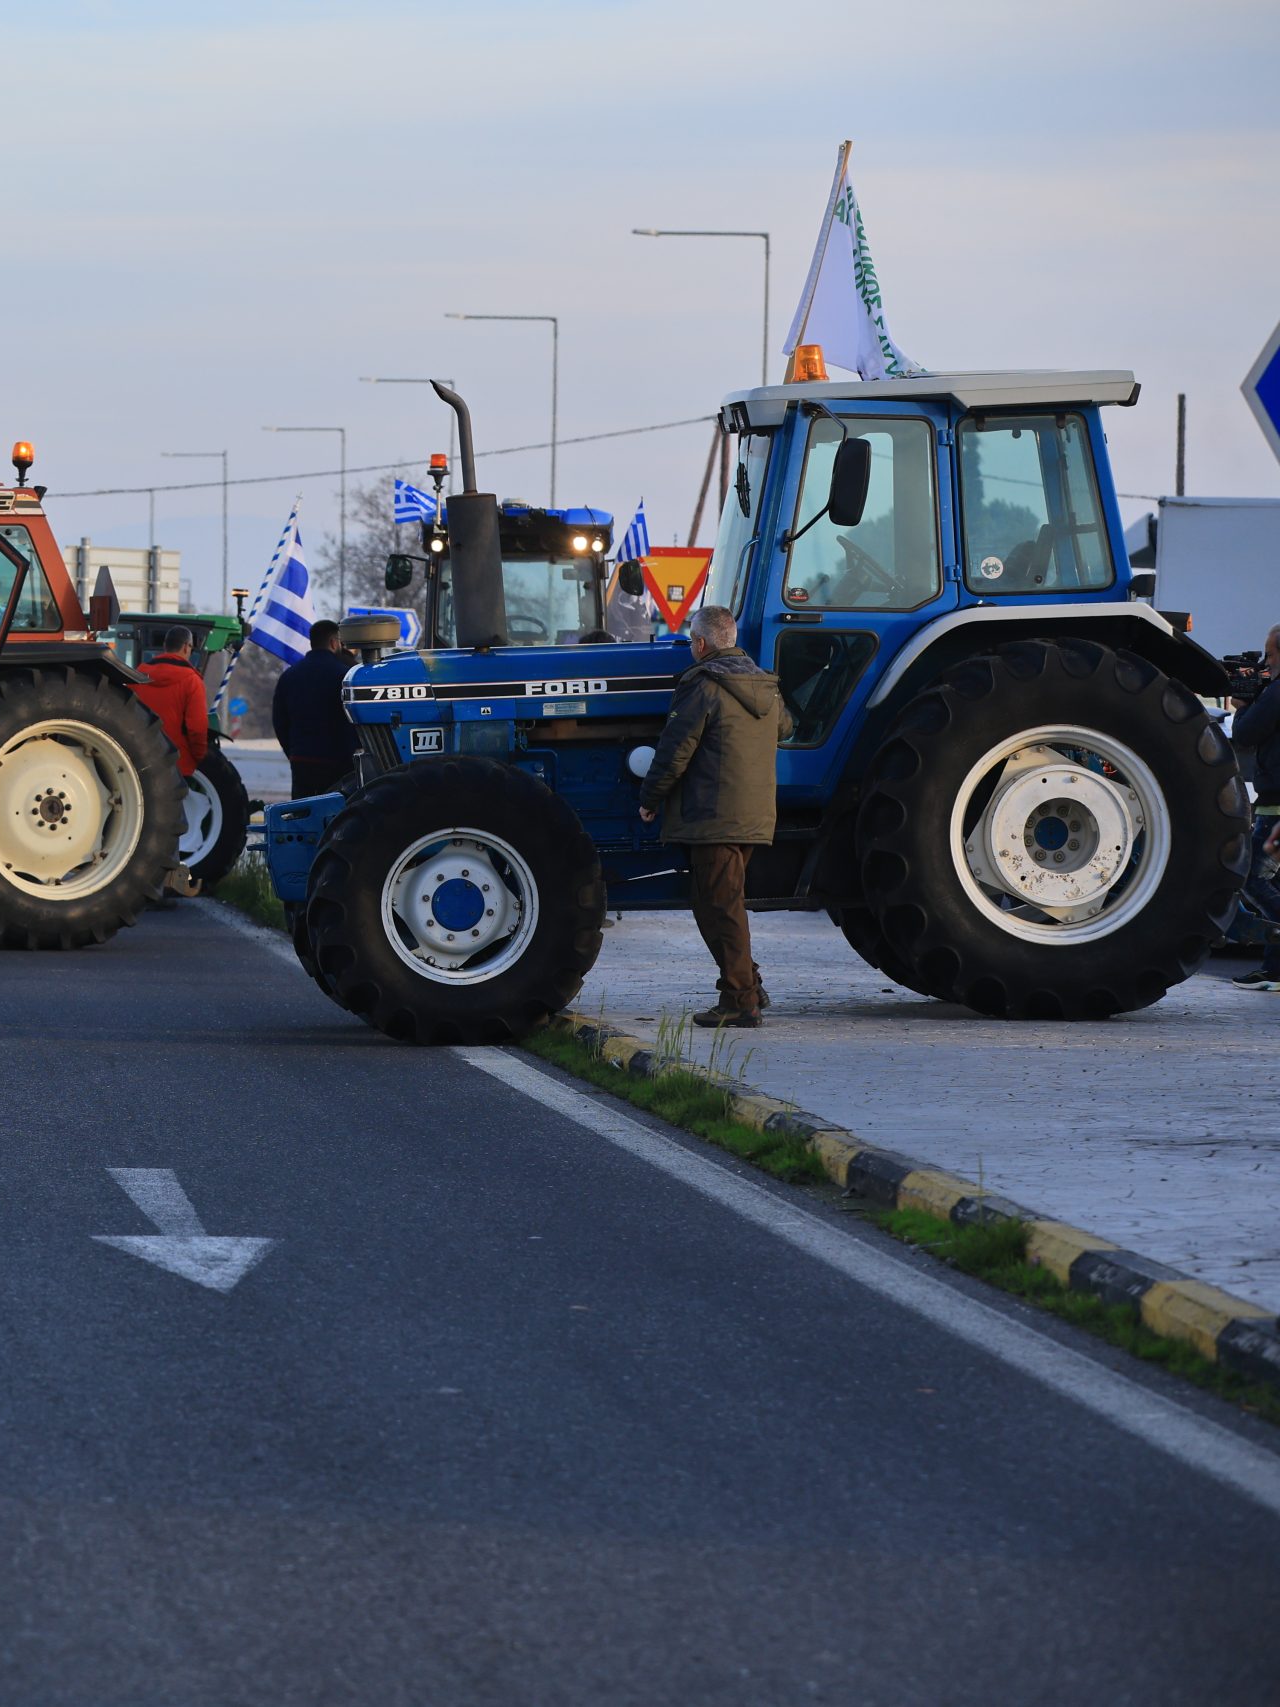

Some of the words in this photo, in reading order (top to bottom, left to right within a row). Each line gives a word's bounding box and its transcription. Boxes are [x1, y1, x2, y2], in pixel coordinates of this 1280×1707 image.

[371, 687, 427, 700] 7810
[525, 680, 608, 696] FORD
[414, 731, 441, 751] III
